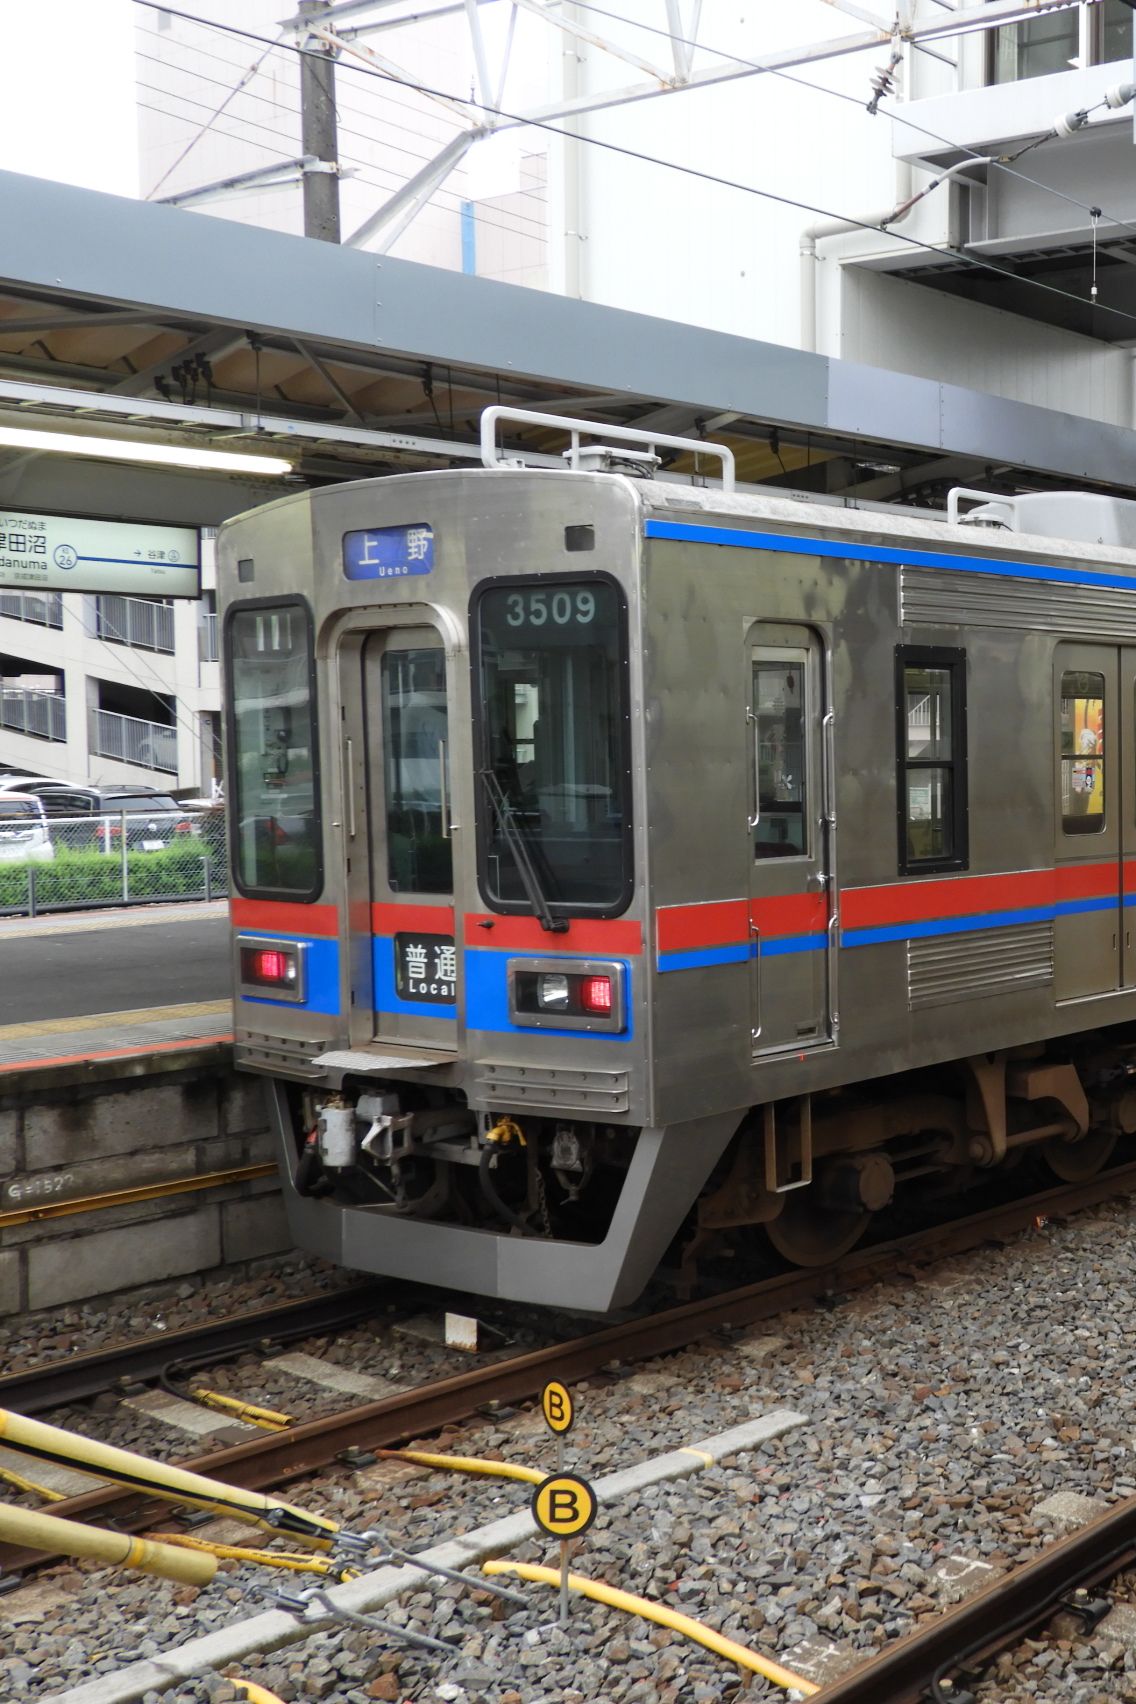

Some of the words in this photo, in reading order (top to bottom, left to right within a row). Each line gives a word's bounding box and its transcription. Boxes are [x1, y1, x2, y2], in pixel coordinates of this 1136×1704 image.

[358, 528, 434, 566] 上野
[379, 566, 408, 576] Ueno
[506, 591, 596, 626] 3509
[405, 943, 457, 981] 普通
[409, 979, 456, 996] Local
[549, 1389, 565, 1422] B
[549, 1489, 580, 1523] B
